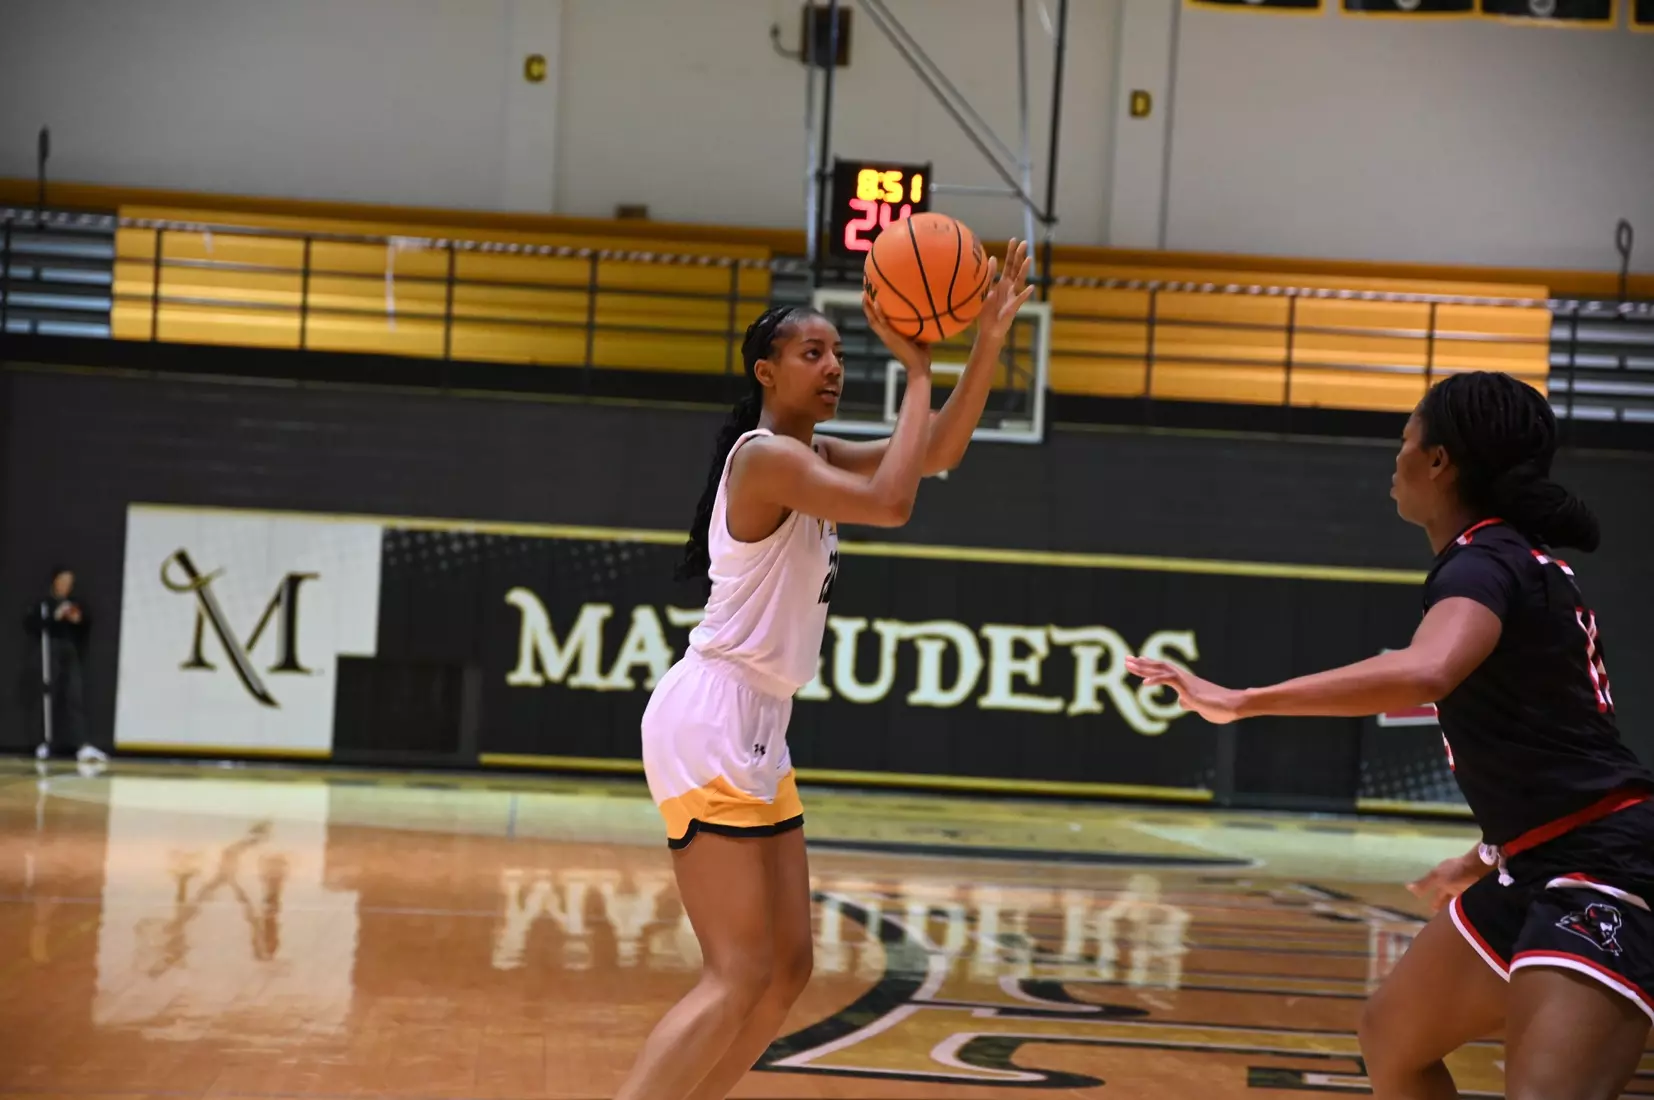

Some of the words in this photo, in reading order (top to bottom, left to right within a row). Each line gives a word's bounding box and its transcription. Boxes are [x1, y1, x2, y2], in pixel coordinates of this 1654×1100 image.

[525, 54, 546, 82] C
[1130, 90, 1152, 118] D
[857, 169, 923, 203] 8:51
[160, 547, 321, 709] M
[505, 587, 1198, 735] MAUDERS
